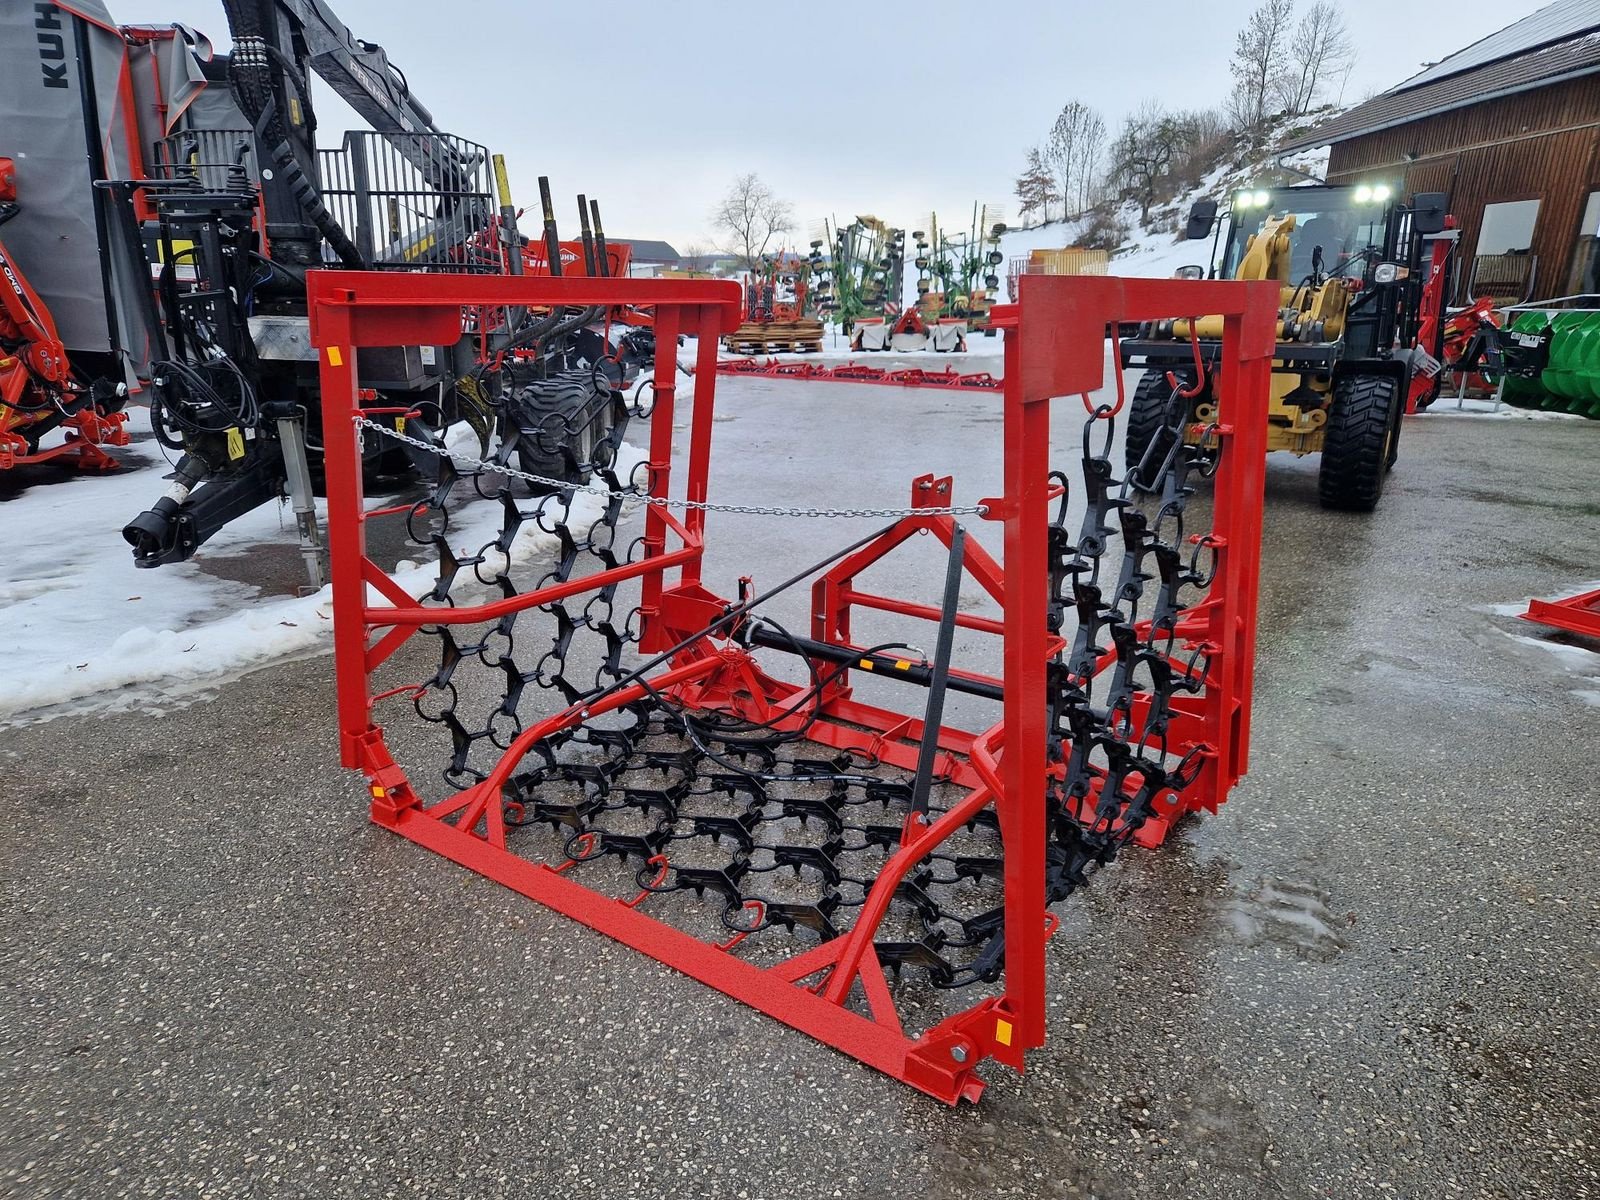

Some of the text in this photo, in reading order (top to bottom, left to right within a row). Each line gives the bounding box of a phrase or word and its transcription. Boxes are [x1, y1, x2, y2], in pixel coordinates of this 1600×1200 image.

[350, 60, 389, 109] PALMS
[560, 253, 575, 261] UHN
[4, 266, 22, 295] GMD
